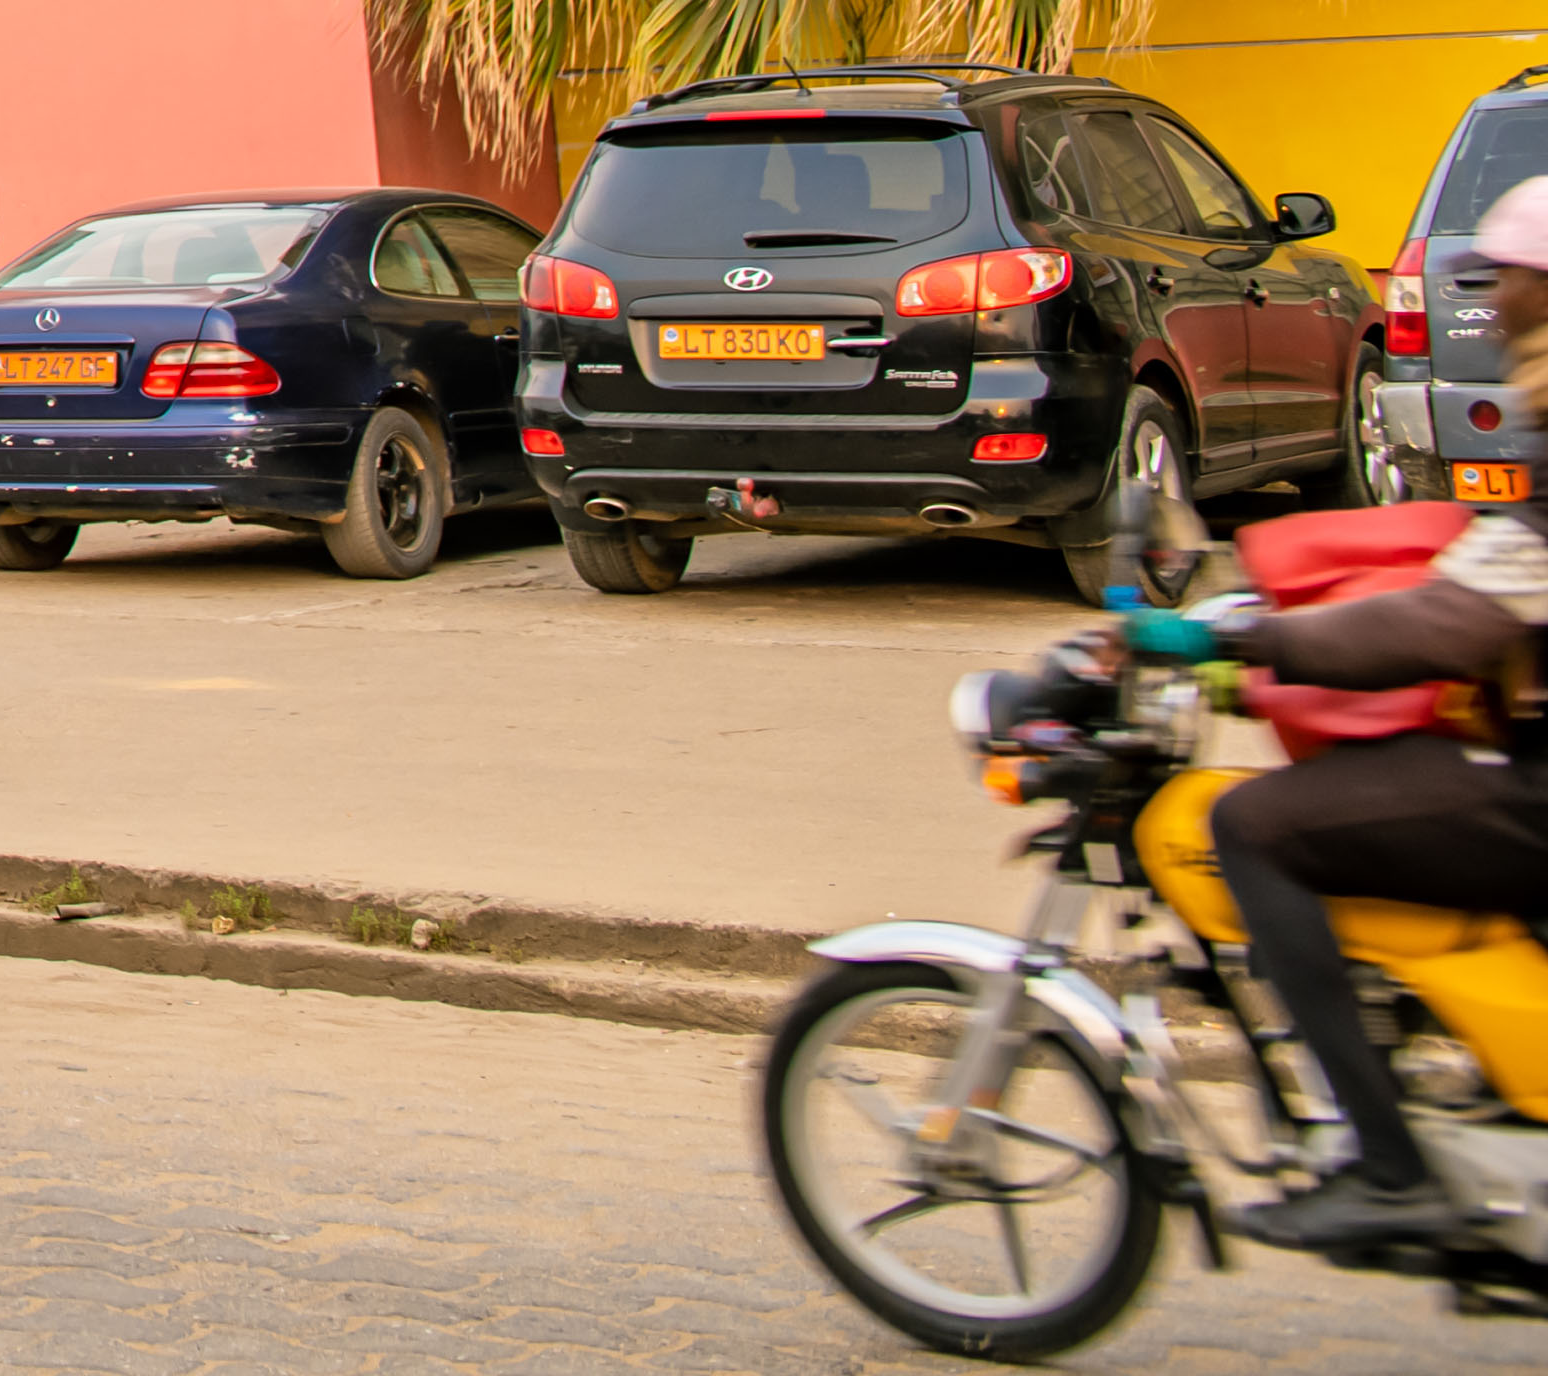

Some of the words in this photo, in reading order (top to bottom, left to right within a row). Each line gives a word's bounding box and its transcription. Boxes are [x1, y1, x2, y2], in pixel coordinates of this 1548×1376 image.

[683, 328, 715, 353] LT
[723, 328, 770, 354] 830
[4, 356, 32, 379] LT
[36, 356, 74, 379] 247
[1485, 468, 1517, 496] LT
